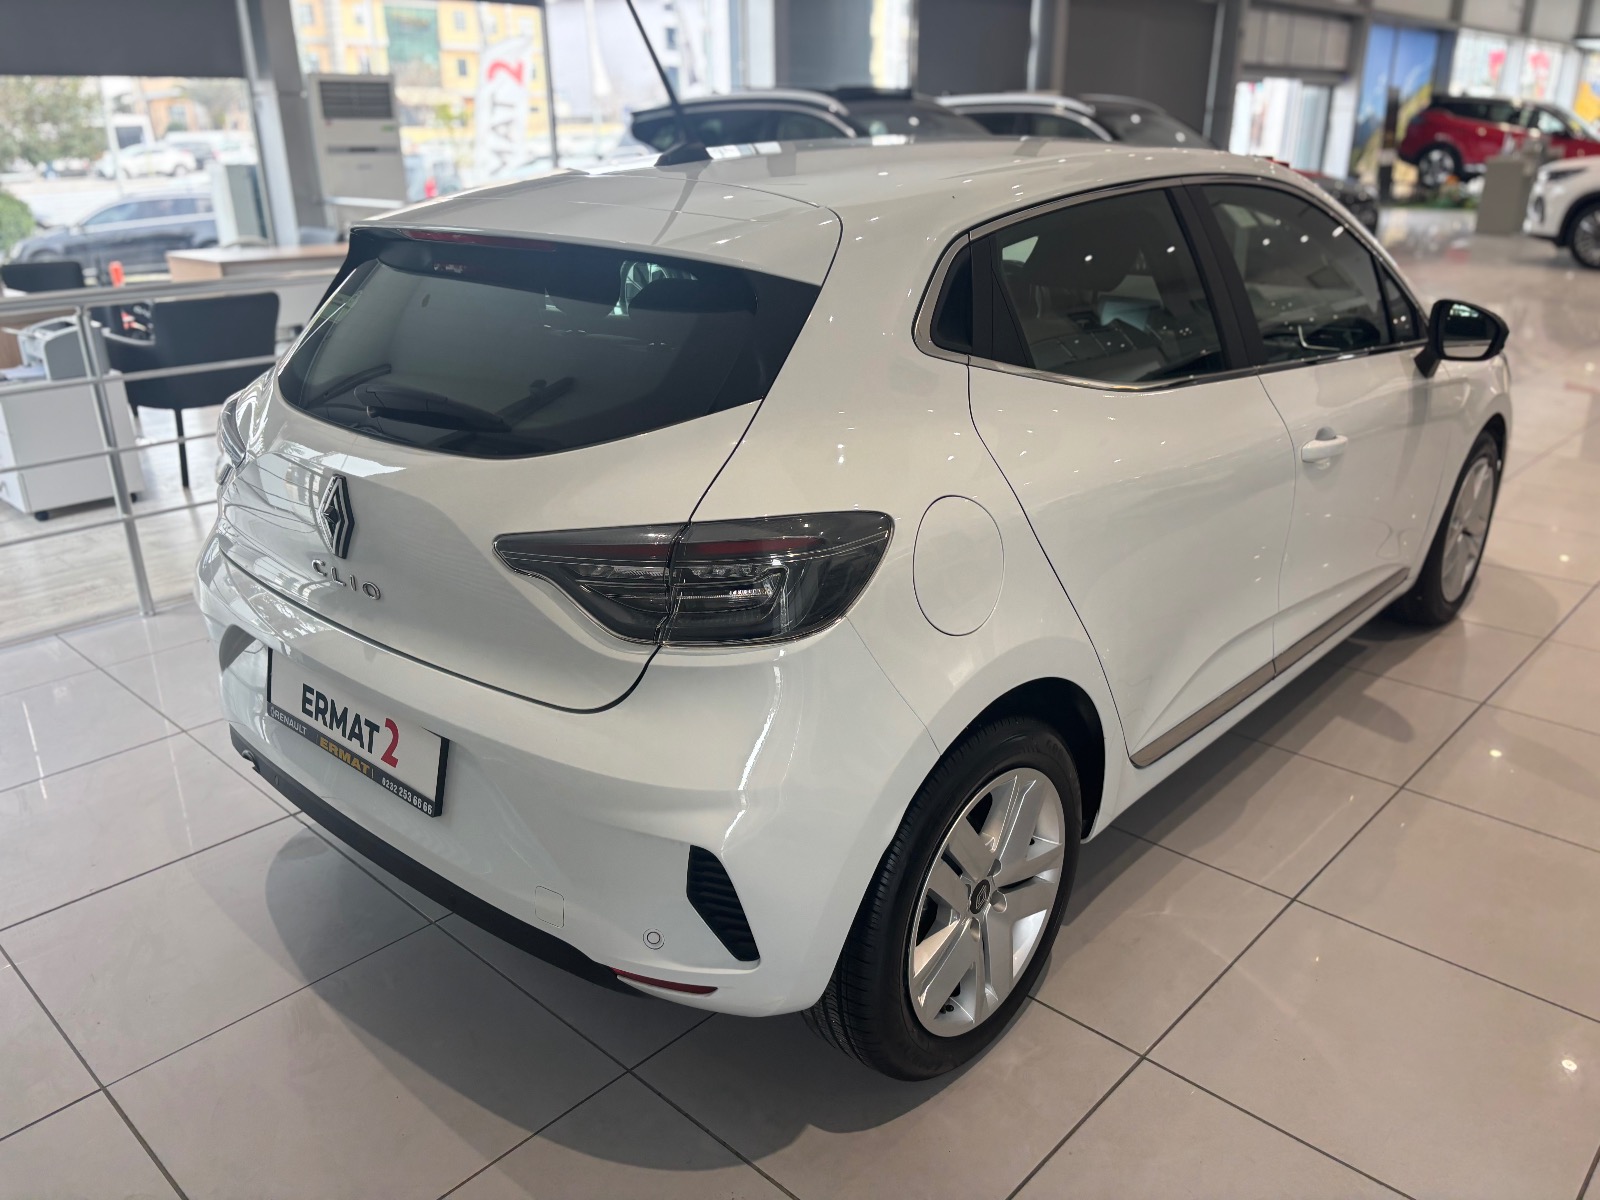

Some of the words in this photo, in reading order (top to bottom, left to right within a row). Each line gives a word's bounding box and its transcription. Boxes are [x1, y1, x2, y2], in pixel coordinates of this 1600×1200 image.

[311, 558, 382, 601] CLIO
[274, 710, 307, 735] RENAULT
[320, 736, 370, 774] ERMAT
